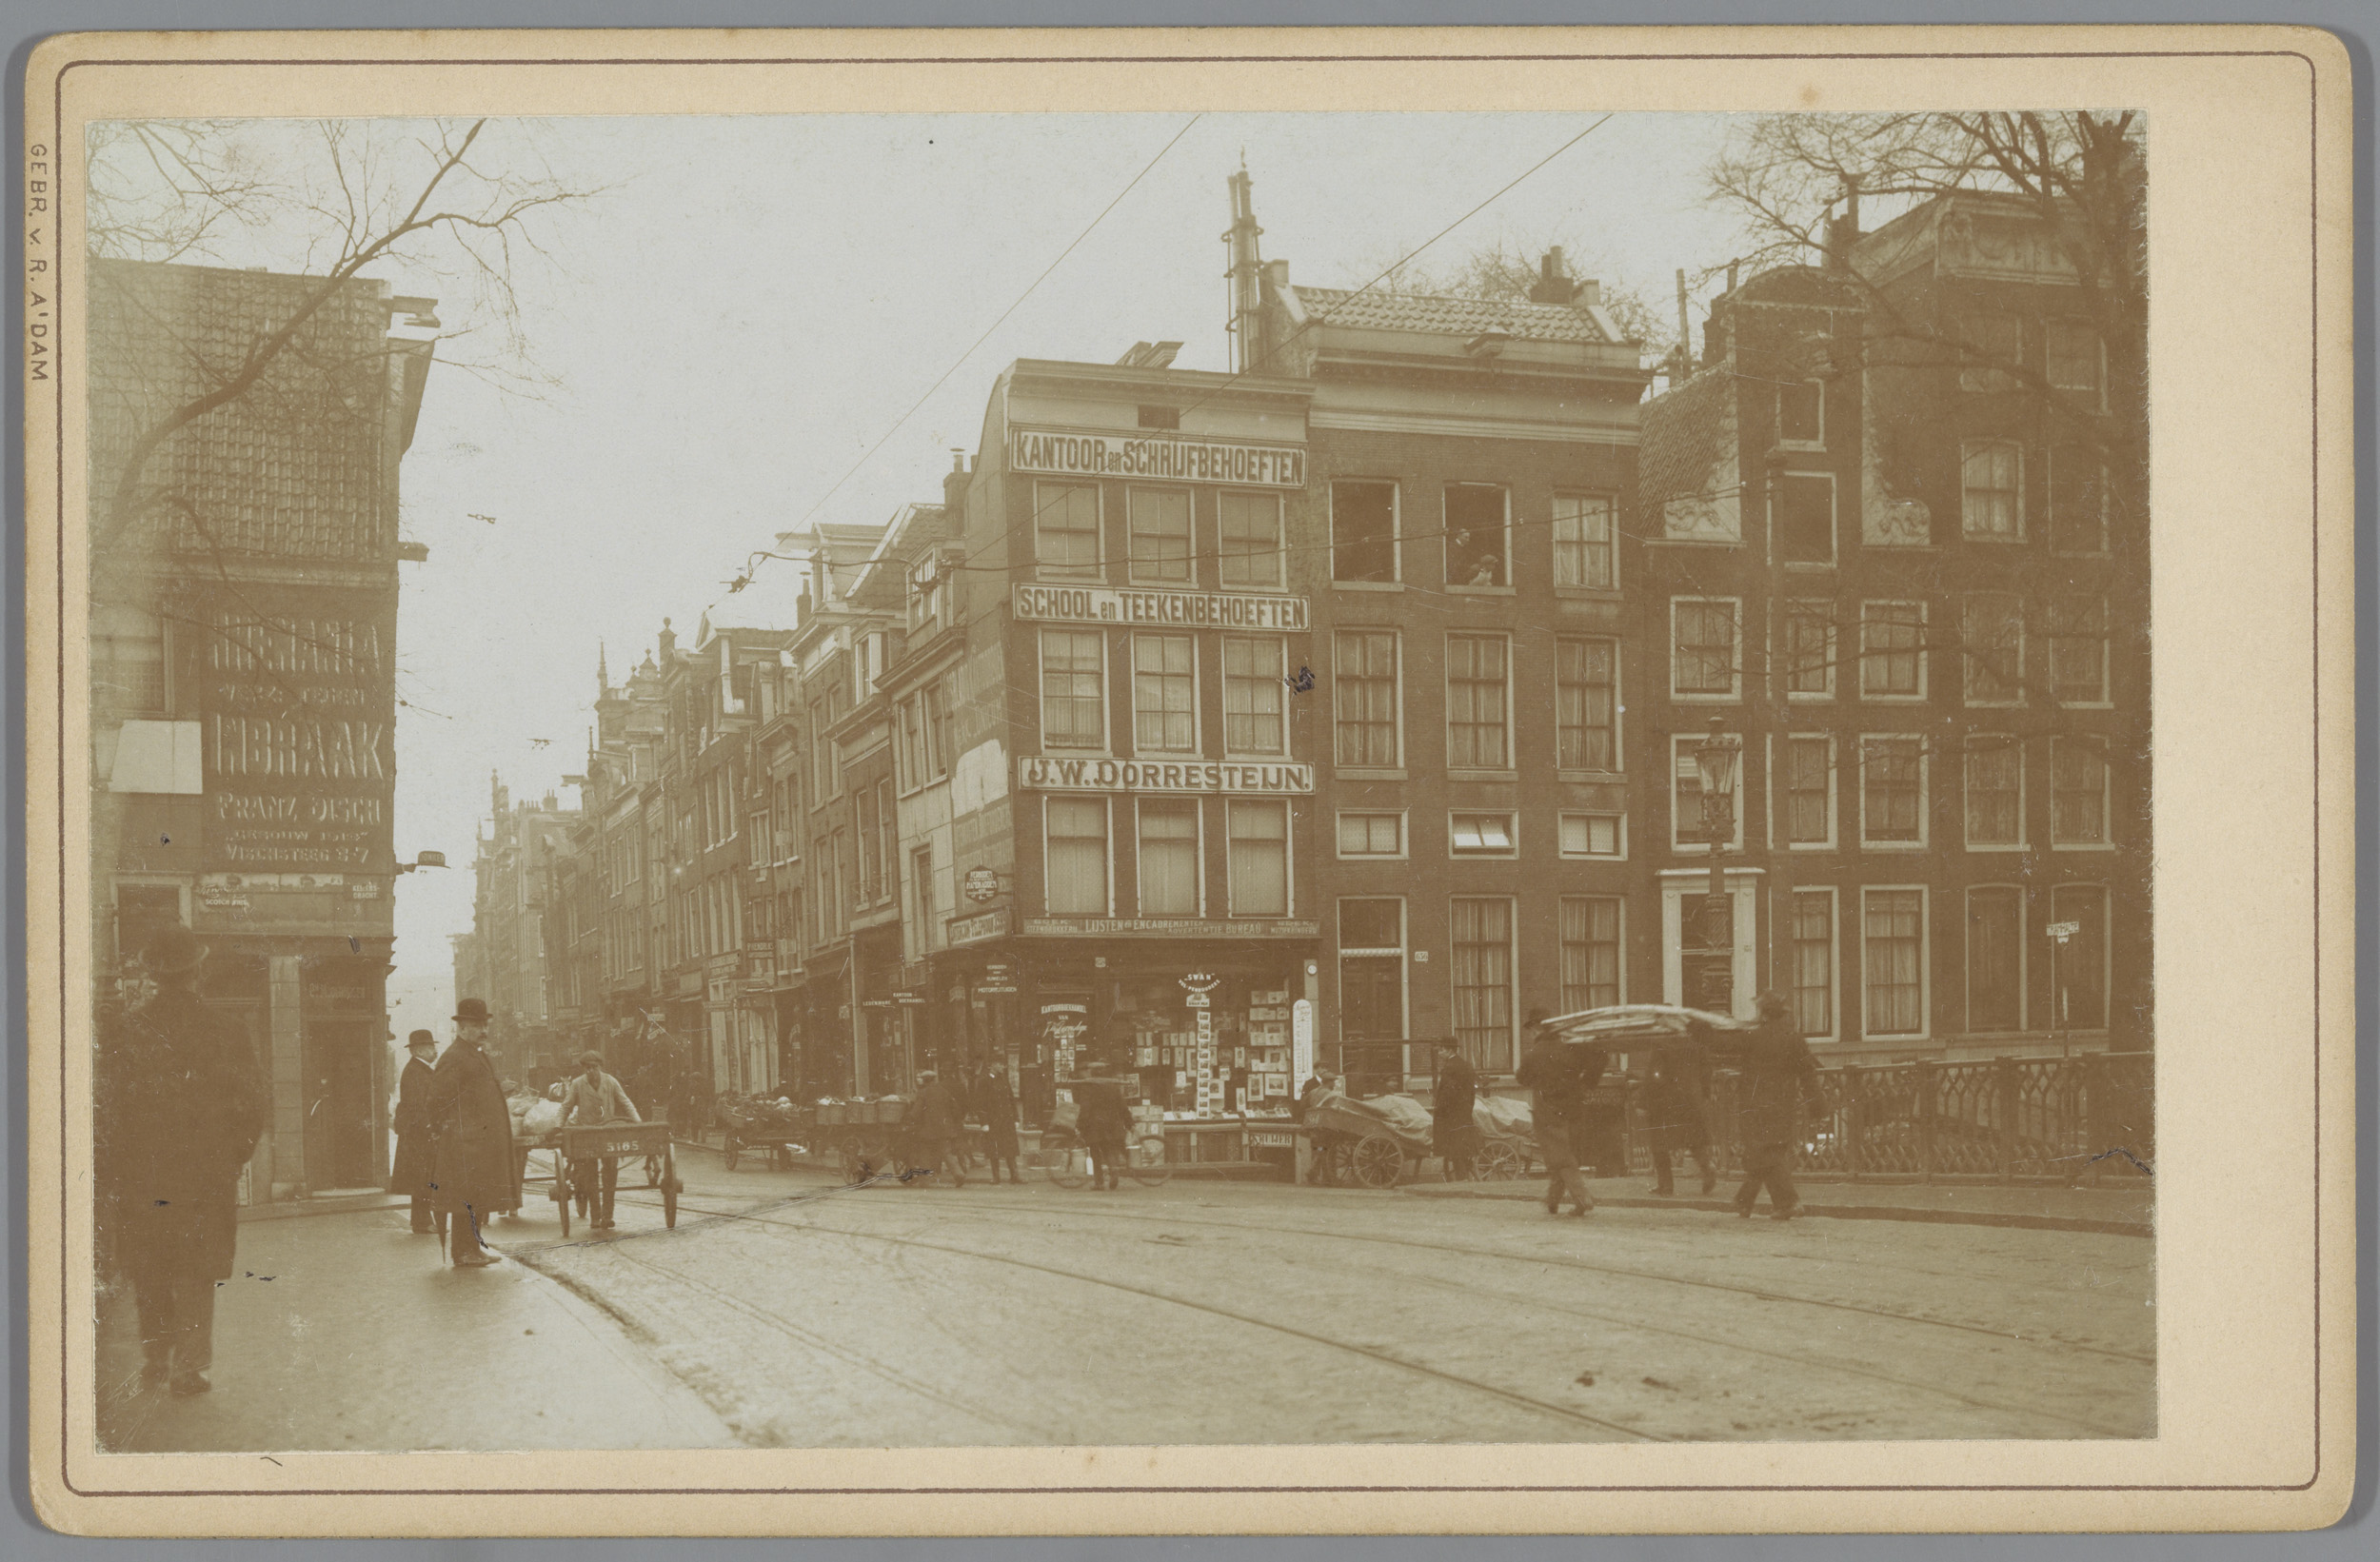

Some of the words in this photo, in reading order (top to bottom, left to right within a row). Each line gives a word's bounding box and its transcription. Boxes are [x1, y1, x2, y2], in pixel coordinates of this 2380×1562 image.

[30, 143, 49, 218] GEBR.
[30, 258, 48, 284] R.
[30, 290, 50, 382] A'DAM
[1016, 433, 1105, 471] KANTOOR
[1107, 451, 1121, 473] en
[1122, 439, 1303, 484] SCHRIJFBEHOEFTEN
[1019, 587, 1098, 620] SCHOOL
[1100, 600, 1116, 621] en
[1119, 592, 1306, 628] TEEKENBEHOEFTEN
[210, 713, 385, 780] INBRAAK
[217, 793, 298, 821] FRANZ
[310, 797, 382, 825] DISCH
[1084, 919, 1123, 934] LIJSTEN
[1225, 923, 1261, 934] BUREAU
[606, 1140, 639, 1152] 5165
